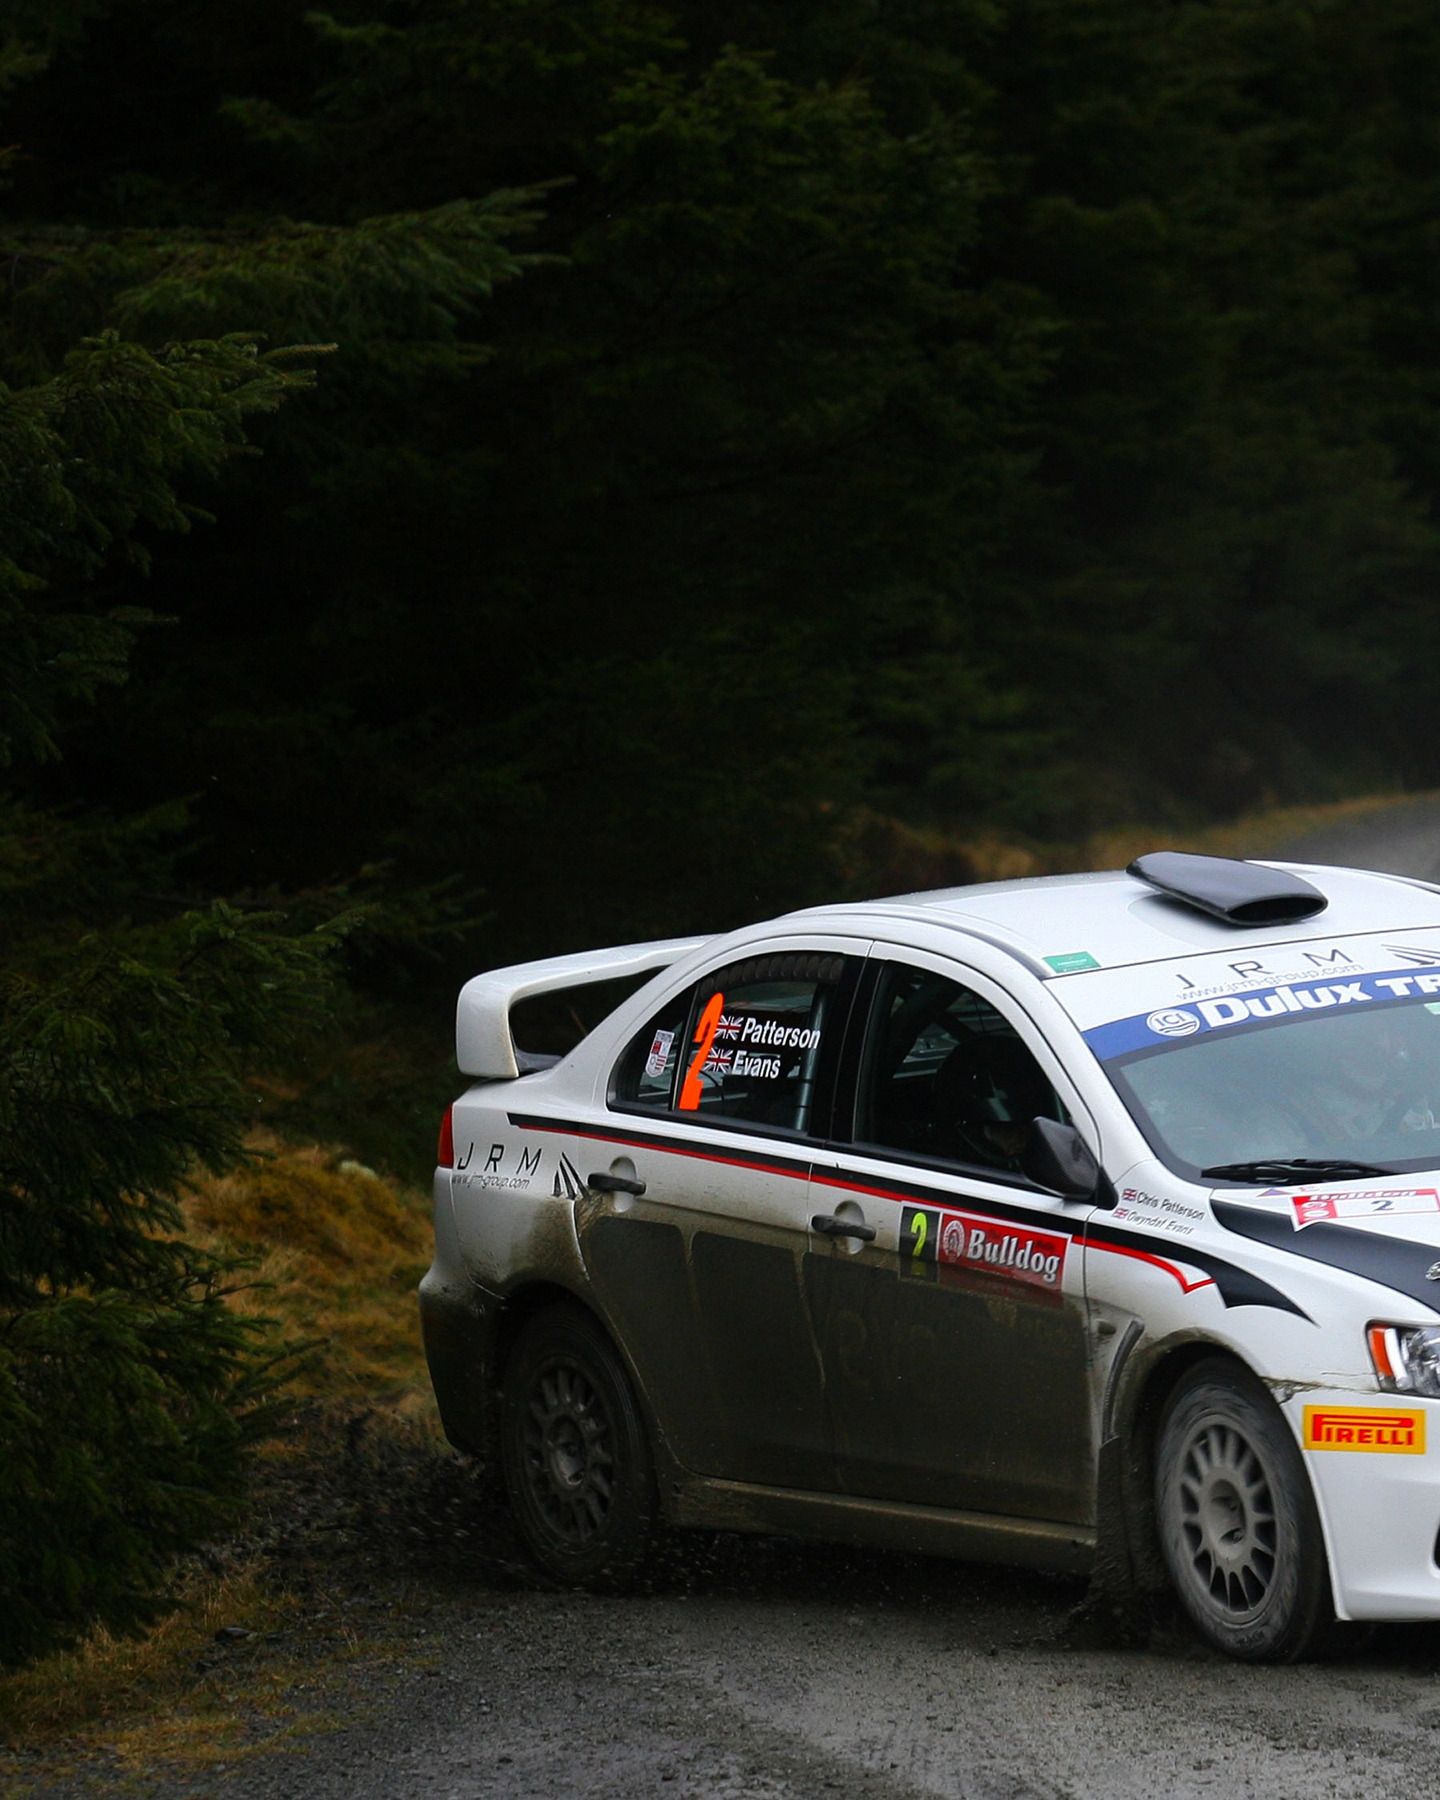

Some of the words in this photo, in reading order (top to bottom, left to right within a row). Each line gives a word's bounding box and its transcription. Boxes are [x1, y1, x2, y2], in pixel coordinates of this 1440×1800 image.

[1155, 1012, 1186, 1028] ICI
[1197, 981, 1373, 1028] Dulux
[740, 1017, 821, 1049] Patterson
[731, 1050, 781, 1079] Evans
[1136, 1192, 1159, 1207] Chris
[1161, 1198, 1205, 1220] Patterson
[1371, 1200, 1395, 1211] 2
[911, 1212, 928, 1276] 2
[966, 1229, 1060, 1282] Bulldog
[1312, 1414, 1415, 1445] PIRELLI
